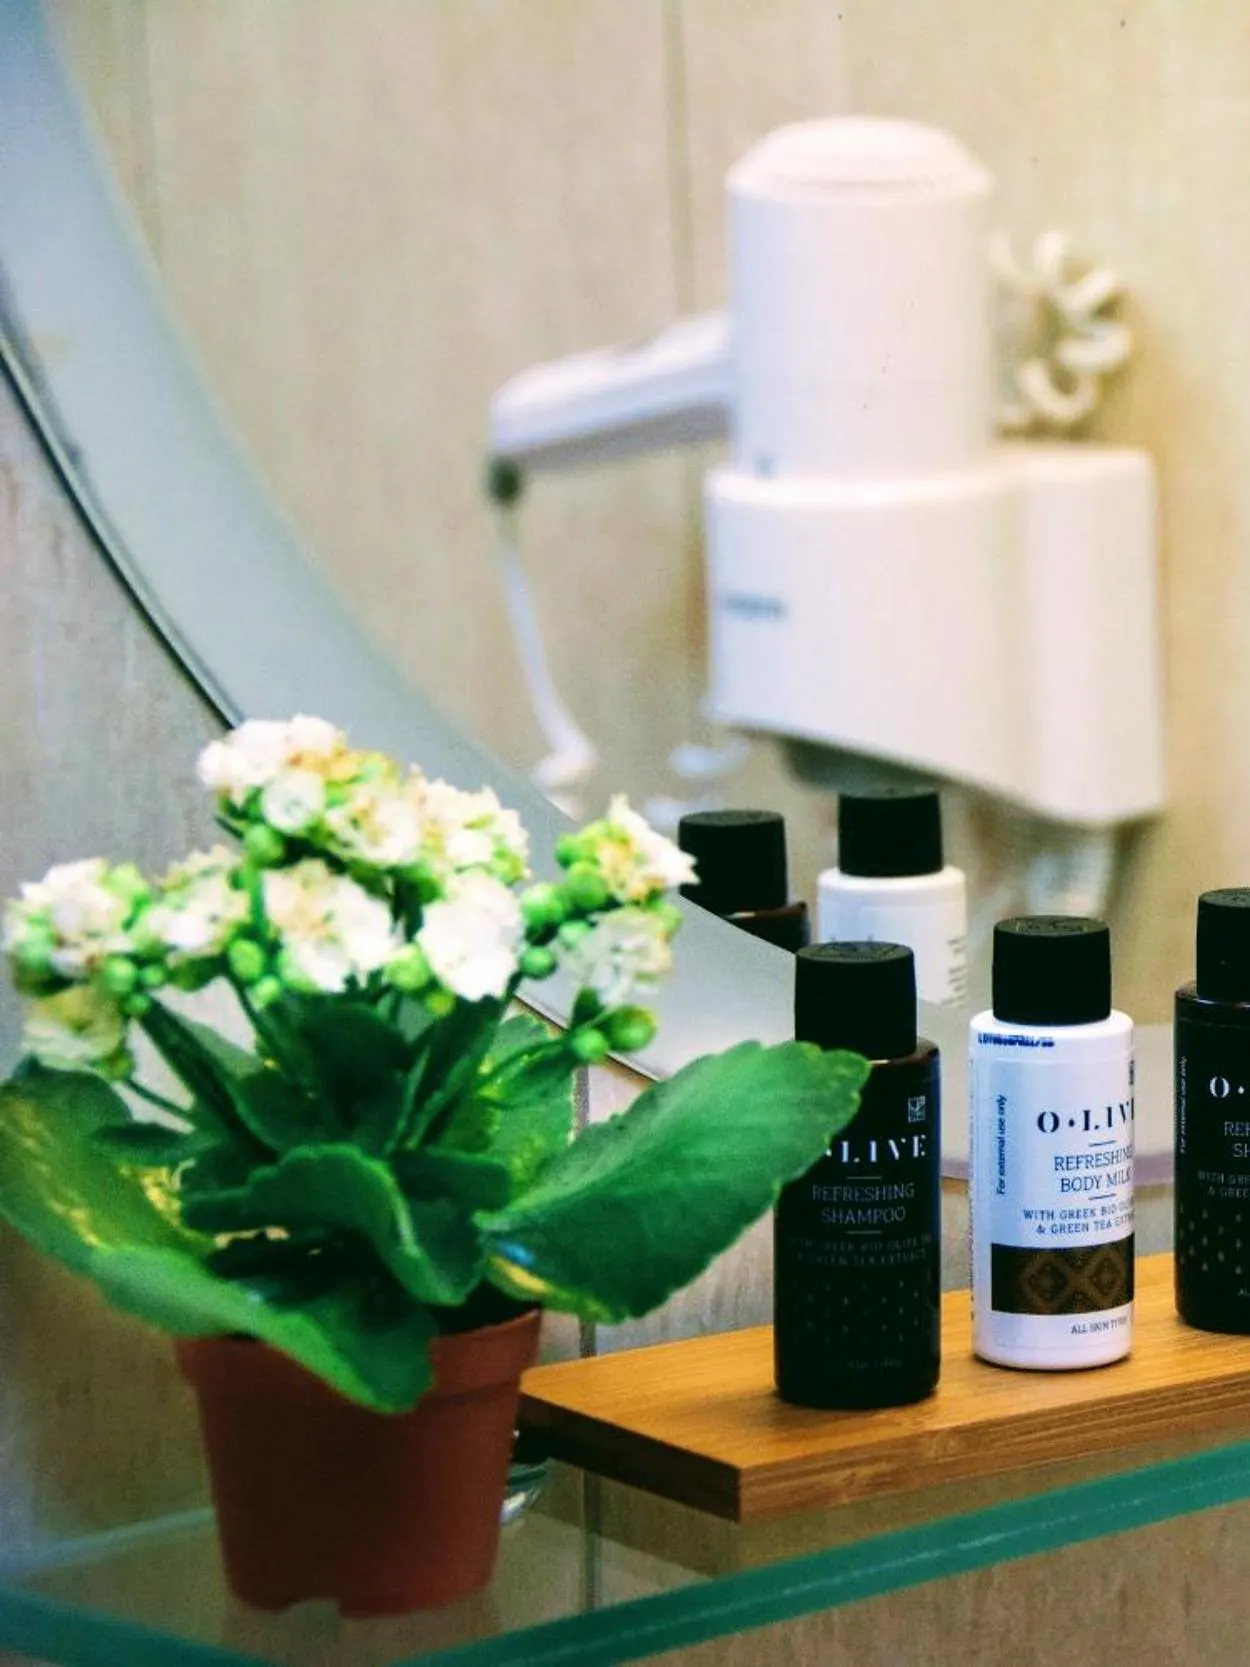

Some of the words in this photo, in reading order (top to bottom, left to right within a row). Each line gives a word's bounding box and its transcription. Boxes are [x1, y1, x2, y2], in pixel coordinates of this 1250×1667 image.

[996, 1095, 1007, 1116] only
[812, 1182, 915, 1202] REFRESHING
[996, 1178, 1005, 1195] For
[1060, 1175, 1102, 1192] BODY
[820, 1206, 907, 1224] SHAMPOO
[1023, 1209, 1054, 1220] WITH
[1059, 1208, 1096, 1220] GREEK
[1036, 1223, 1046, 1234] &
[1051, 1223, 1089, 1234] GREEN
[1094, 1219, 1112, 1231] TEA
[1071, 1323, 1087, 1334] ALL
